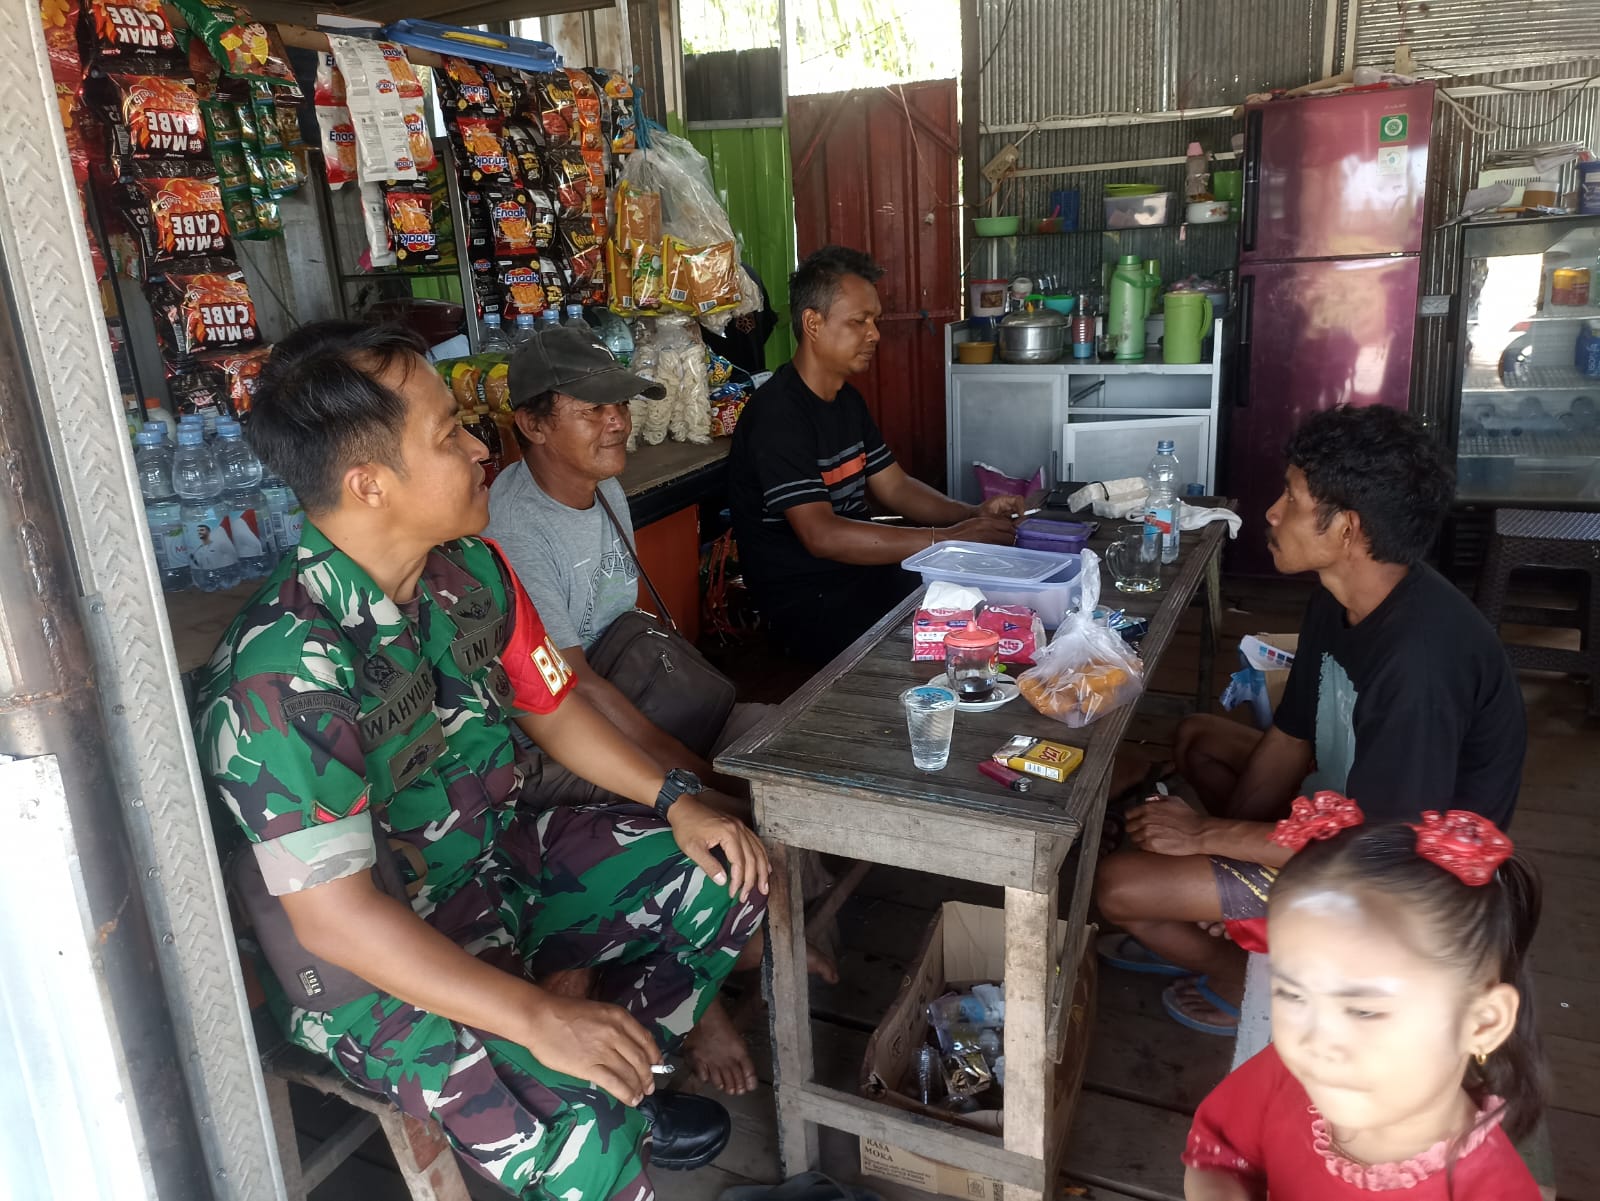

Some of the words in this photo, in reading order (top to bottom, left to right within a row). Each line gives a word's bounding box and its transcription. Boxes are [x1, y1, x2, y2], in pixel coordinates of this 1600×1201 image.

[106, 6, 164, 31] CABE
[116, 27, 159, 47] MAK
[150, 134, 188, 151] MAK
[330, 130, 356, 142] Enaa
[474, 155, 509, 168] Enaak
[160, 200, 170, 211] 15
[495, 207, 526, 218] Enaak
[170, 213, 220, 235] CABE
[175, 235, 211, 251] MAK
[400, 233, 436, 246] Enaak
[504, 273, 540, 285] Enaak
[190, 291, 200, 301] 15
[200, 305, 249, 325] CABE
[205, 326, 241, 341] MAK
[462, 638, 488, 666] TNI
[866, 1138, 890, 1152] RASA
[864, 1146, 894, 1162] MOKA
